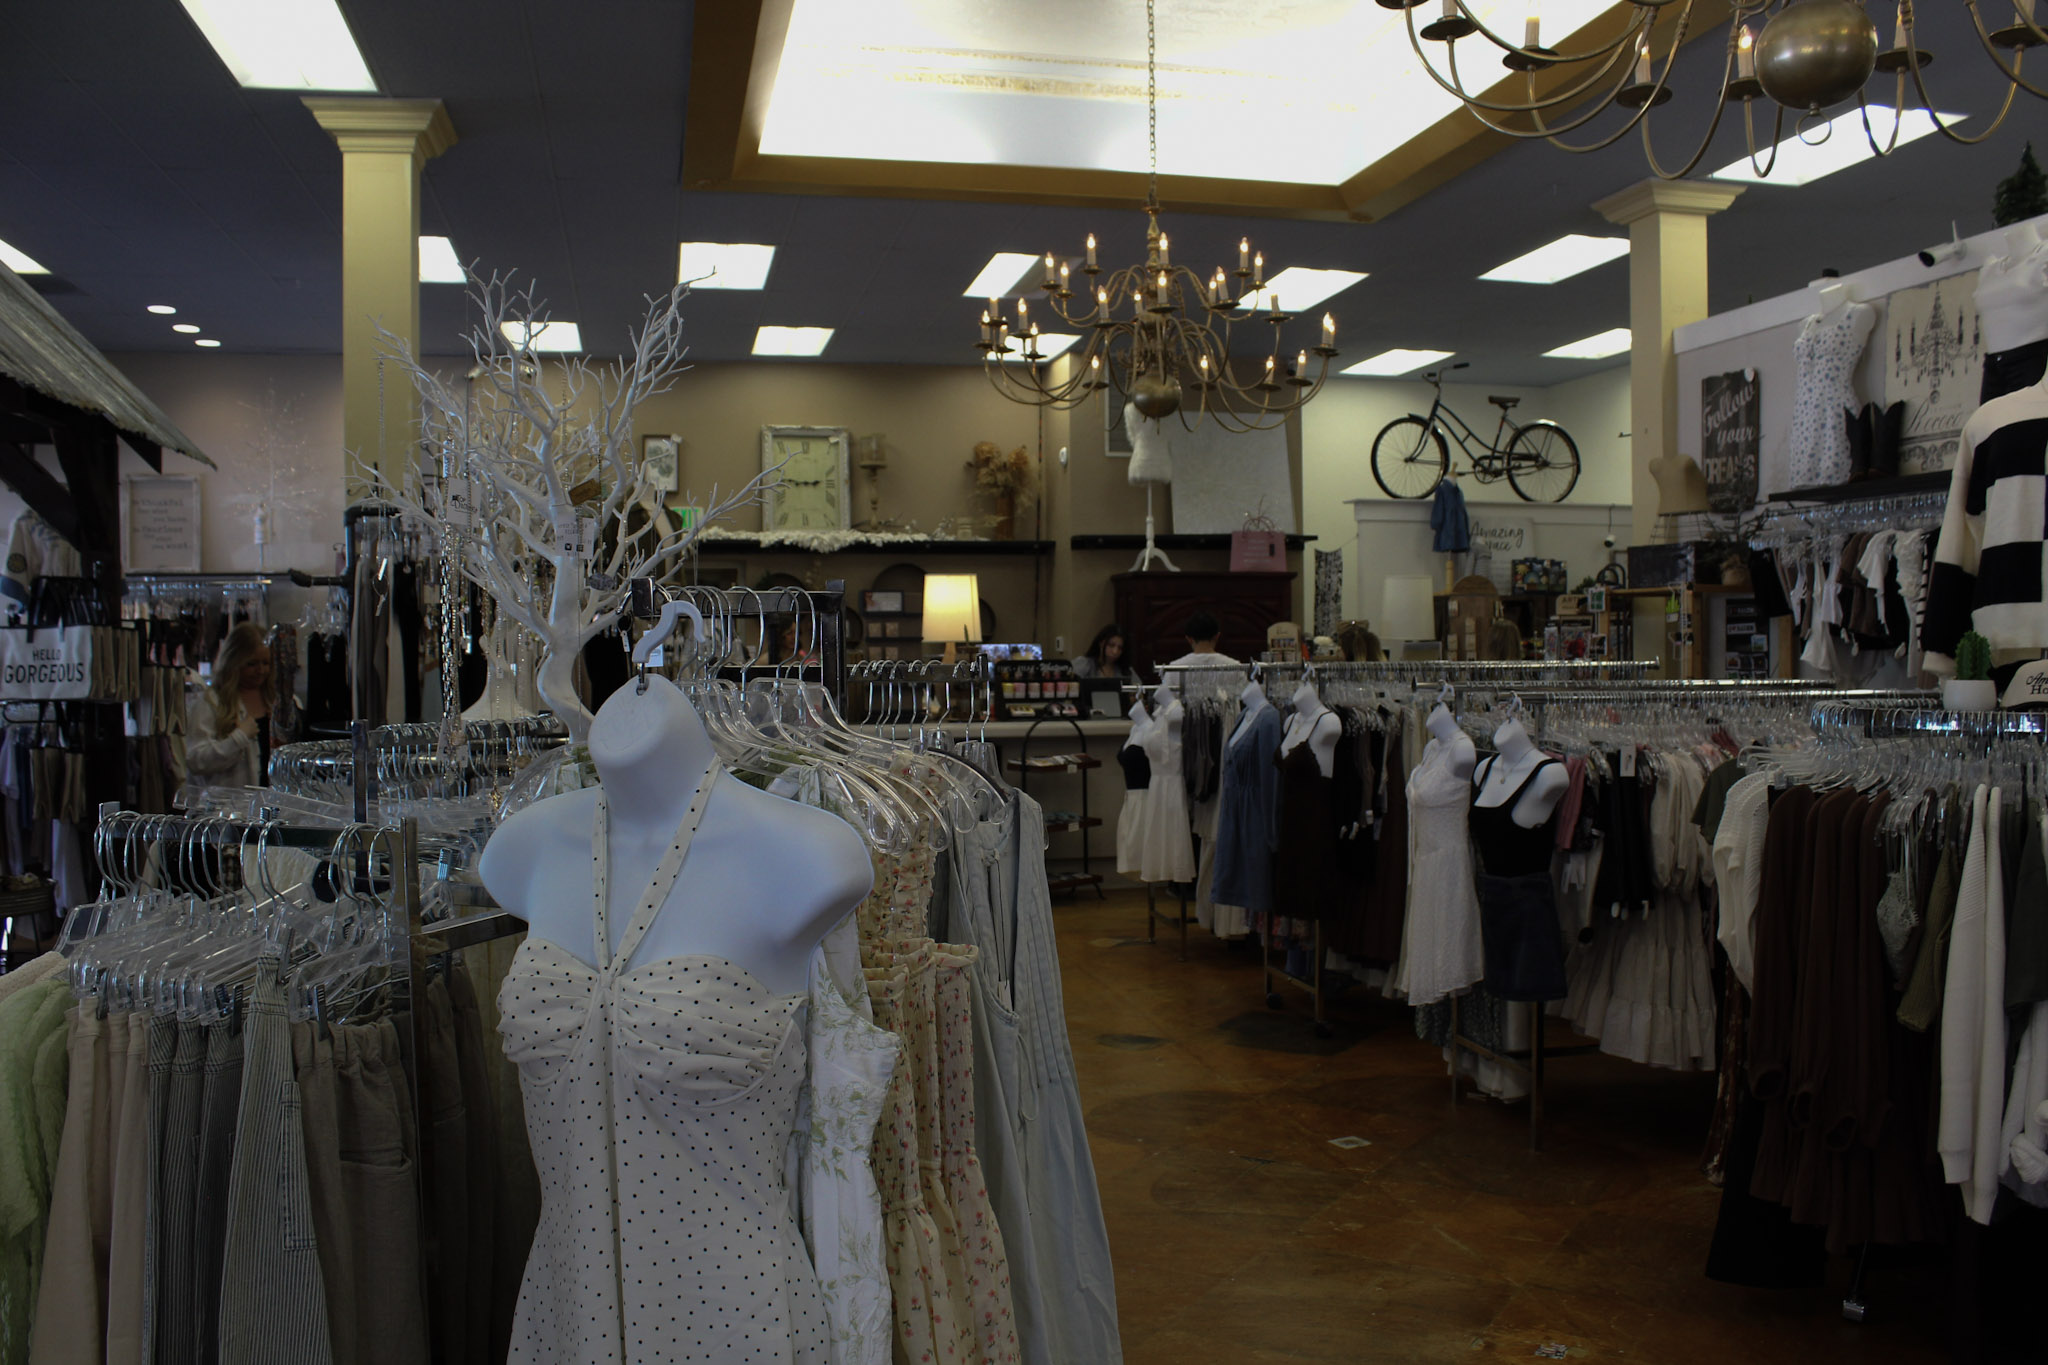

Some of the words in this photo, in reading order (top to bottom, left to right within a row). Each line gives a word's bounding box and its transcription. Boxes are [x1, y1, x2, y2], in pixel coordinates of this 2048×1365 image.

[1704, 383, 1755, 437] Follow
[1717, 425, 1754, 453] your
[1471, 521, 1524, 549] Amazing
[33, 648, 62, 661] HELLO
[4, 662, 84, 684] GORGEOUS
